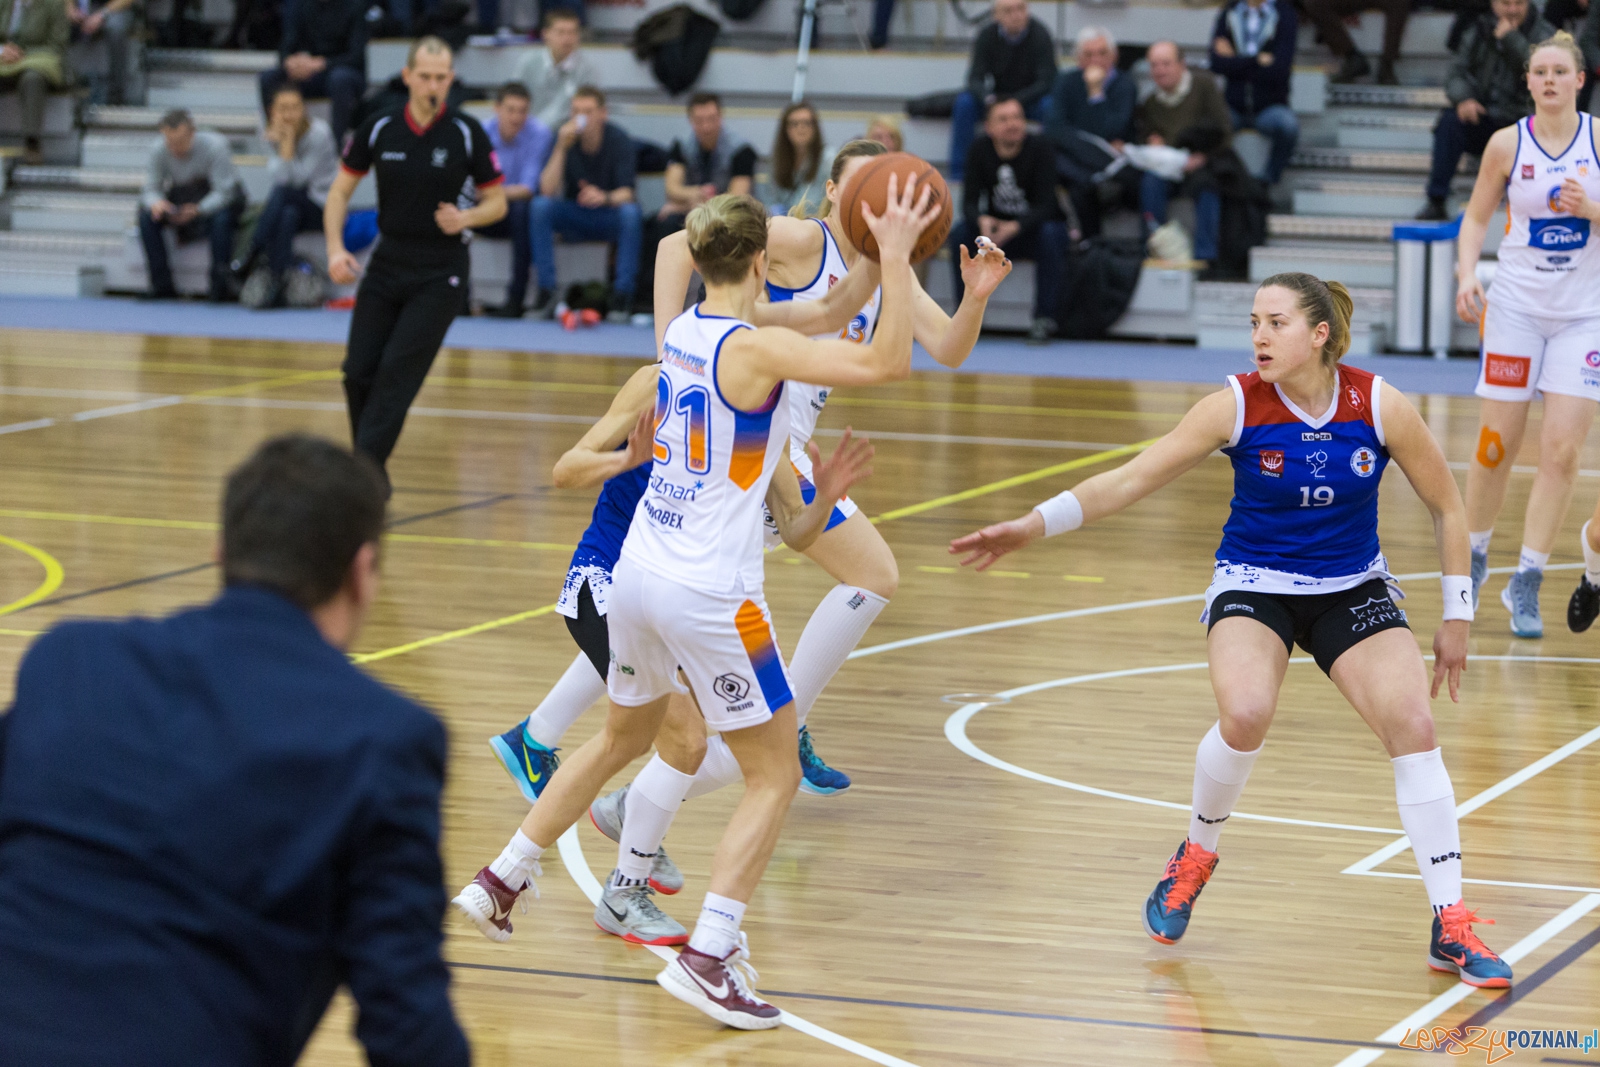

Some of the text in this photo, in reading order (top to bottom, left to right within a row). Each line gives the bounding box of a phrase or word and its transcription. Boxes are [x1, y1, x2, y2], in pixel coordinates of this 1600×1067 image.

[1542, 230, 1583, 245] Enea
[652, 369, 712, 476] 21
[1299, 485, 1335, 507] 19
[1356, 604, 1394, 620] KMM
